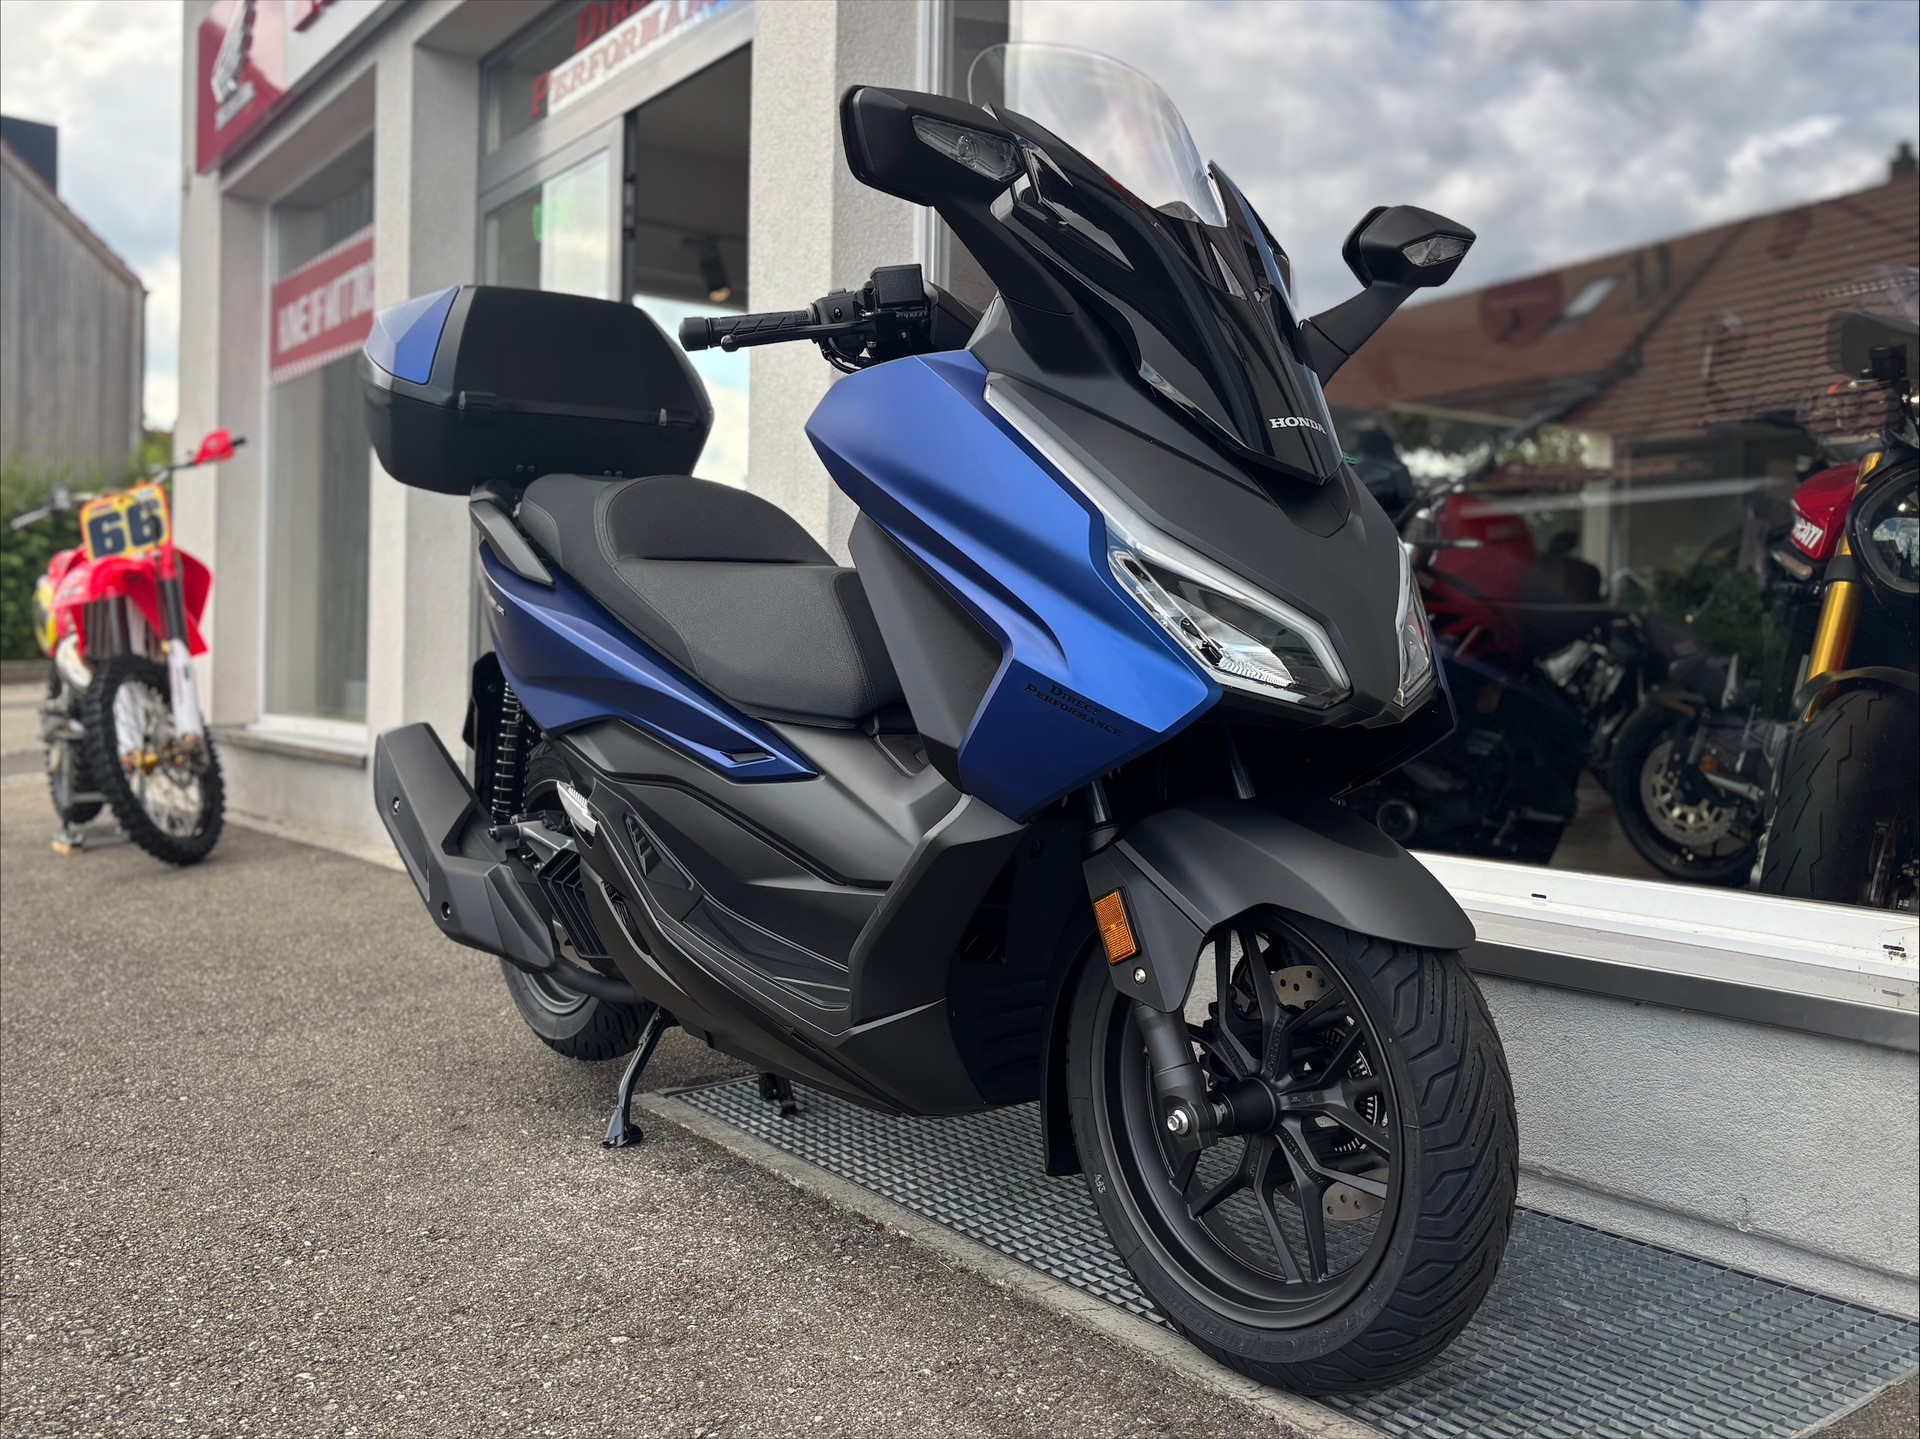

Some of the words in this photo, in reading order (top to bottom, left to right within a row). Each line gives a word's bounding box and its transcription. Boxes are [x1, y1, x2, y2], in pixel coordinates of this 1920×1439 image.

[1268, 416, 1327, 435] HONDA
[88, 499, 164, 559] 66
[1025, 682, 1123, 737] PERFORMANCE
[1049, 684, 1102, 715] DIRECT
